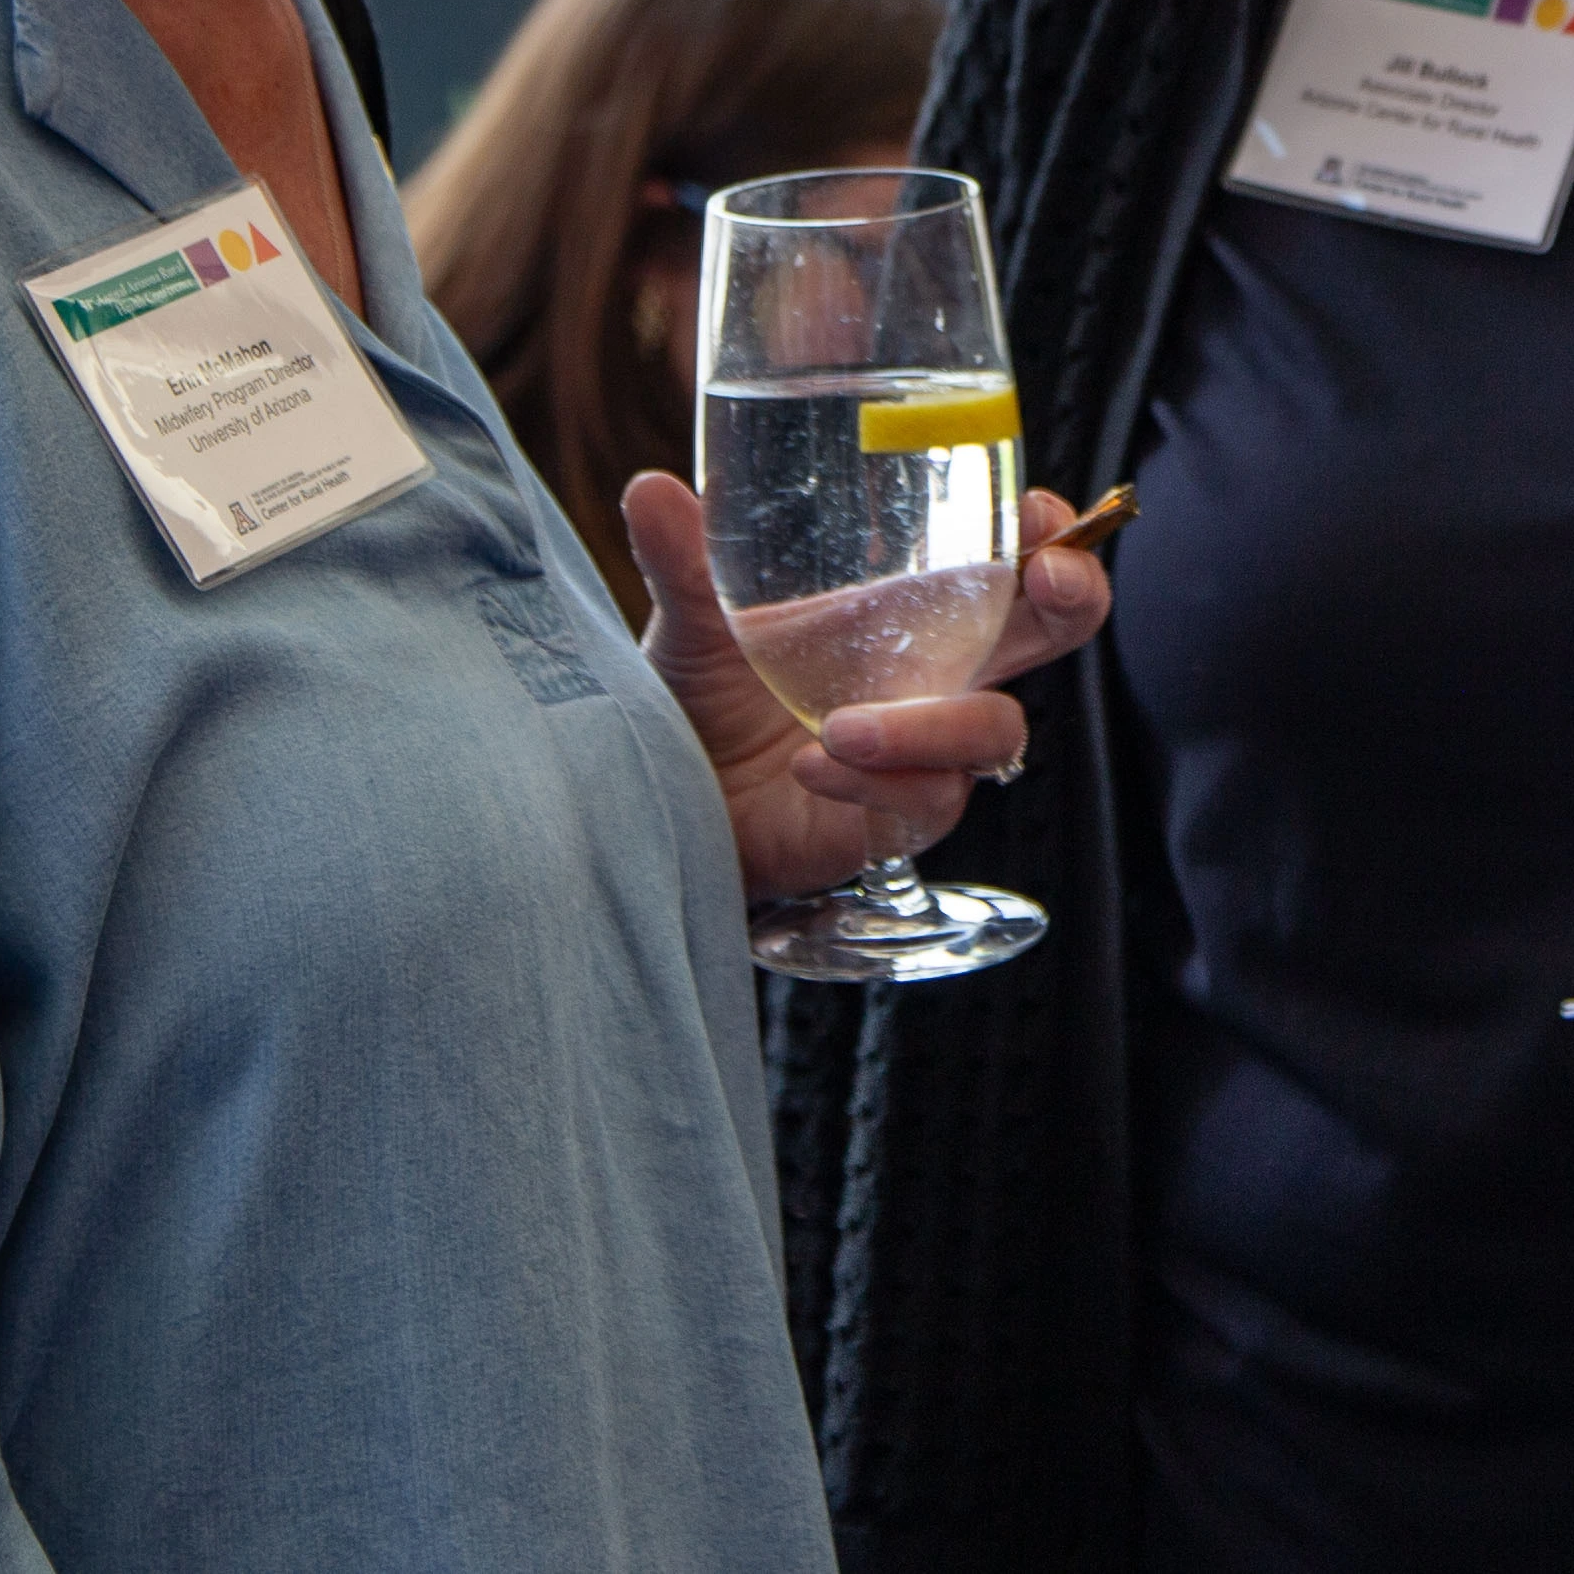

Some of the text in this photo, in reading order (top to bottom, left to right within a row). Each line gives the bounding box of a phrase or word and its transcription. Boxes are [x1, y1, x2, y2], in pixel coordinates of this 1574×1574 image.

[154, 354, 316, 436] Midwifery Program Director
[166, 340, 273, 396] Erin McMahon
[187, 388, 312, 453] University of Arizona
